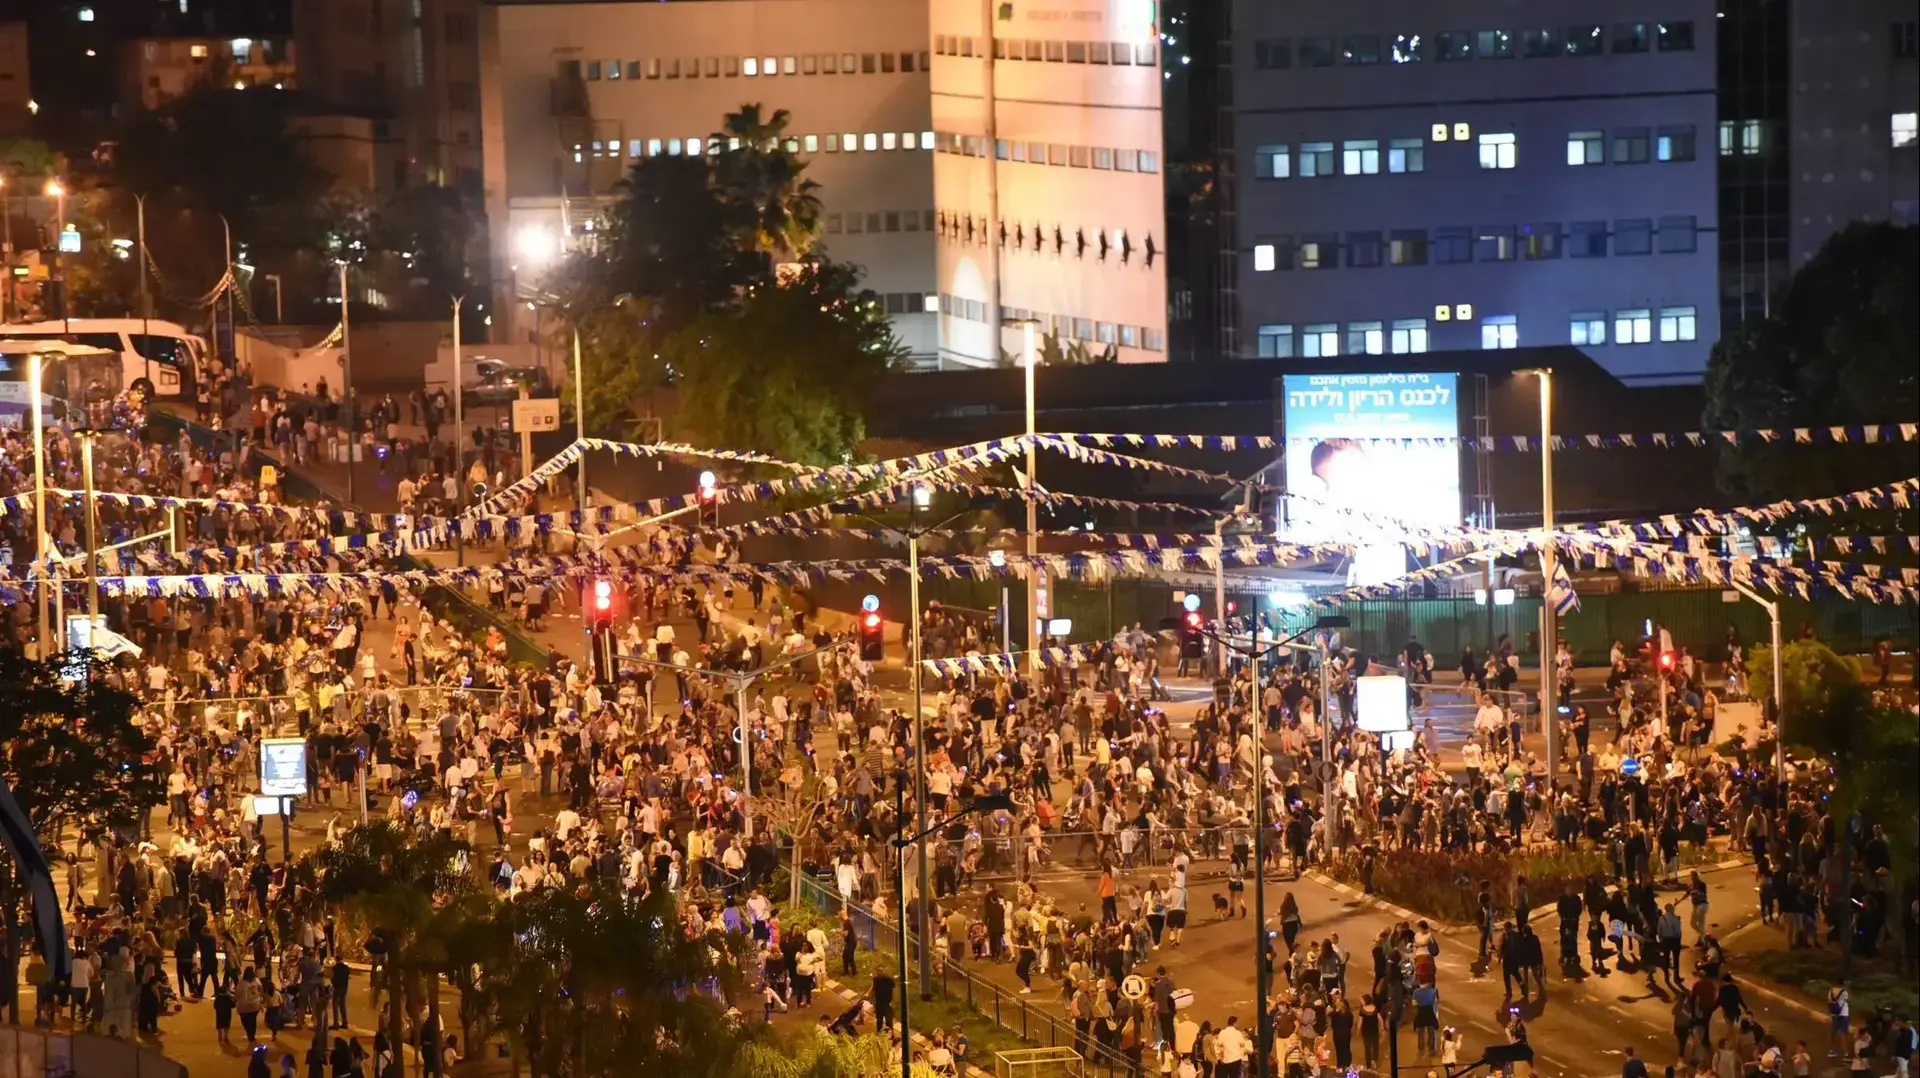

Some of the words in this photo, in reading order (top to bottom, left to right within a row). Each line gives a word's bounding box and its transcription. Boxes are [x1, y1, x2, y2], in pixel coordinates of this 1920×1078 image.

[1309, 376, 1339, 385] אתכם
[1289, 386, 1343, 407] ולידה
[1348, 389, 1394, 412] הריון
[1400, 384, 1450, 406] לכנס
